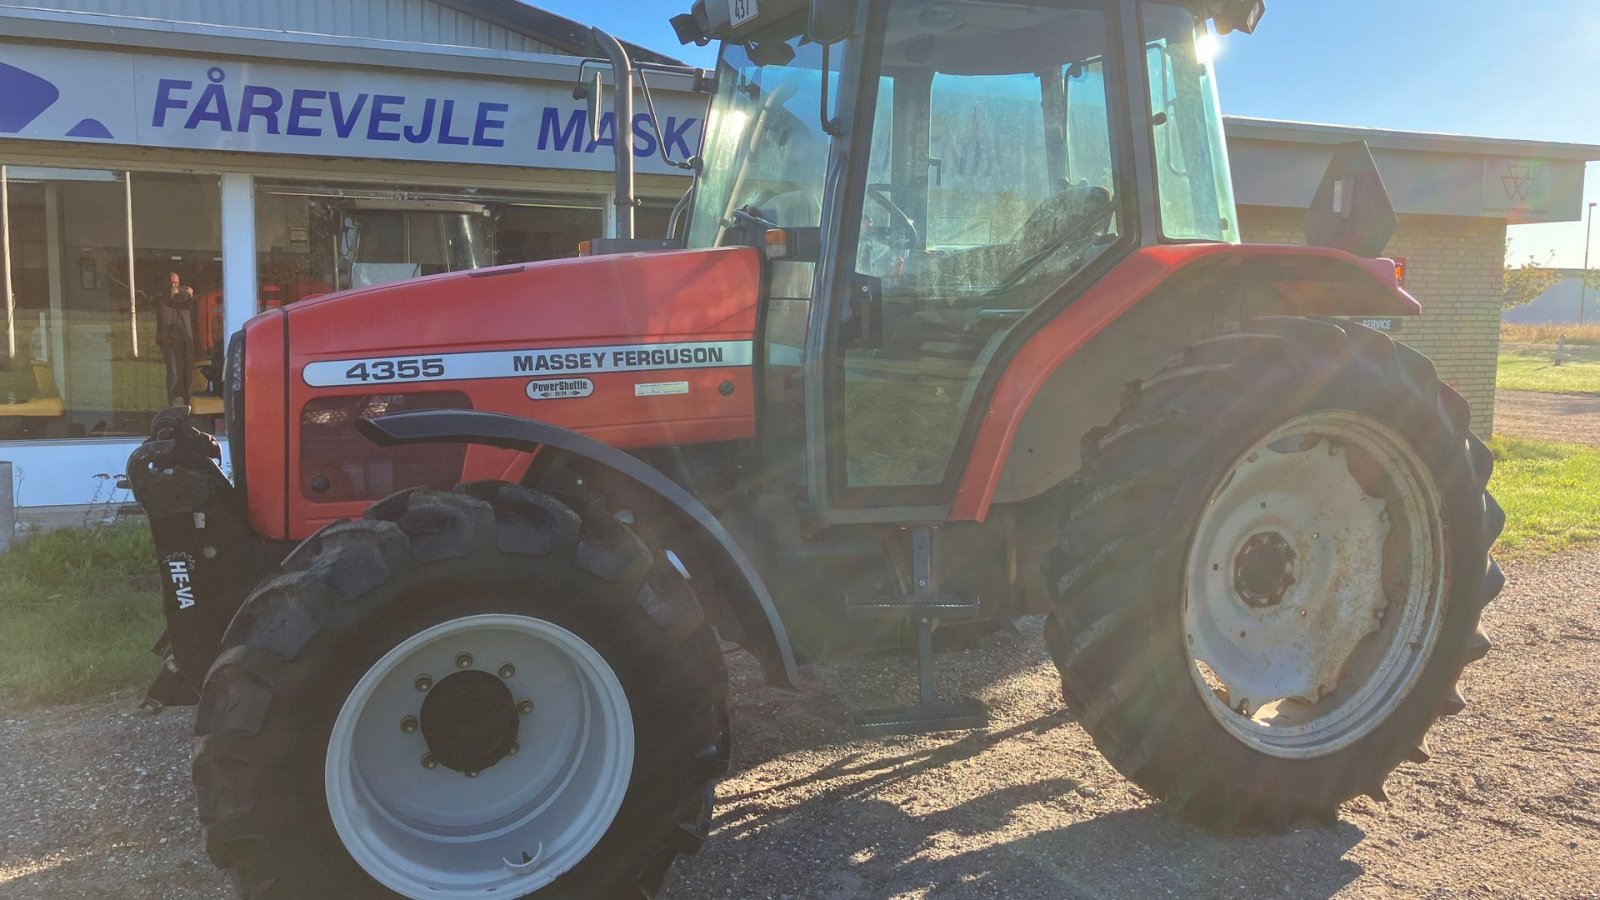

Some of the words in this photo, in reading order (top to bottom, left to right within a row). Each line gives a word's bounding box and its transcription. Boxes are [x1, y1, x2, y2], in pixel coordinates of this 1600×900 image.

[152, 67, 509, 147] FÅREVEJLE
[537, 107, 704, 159] MASK
[1363, 319, 1391, 330] SERVICE
[346, 358, 445, 381] 4355
[513, 352, 606, 372] MASSEY
[613, 347, 723, 367] FERGUSON
[532, 380, 588, 392] PowerShuttle
[168, 561, 195, 609] HE-VA
